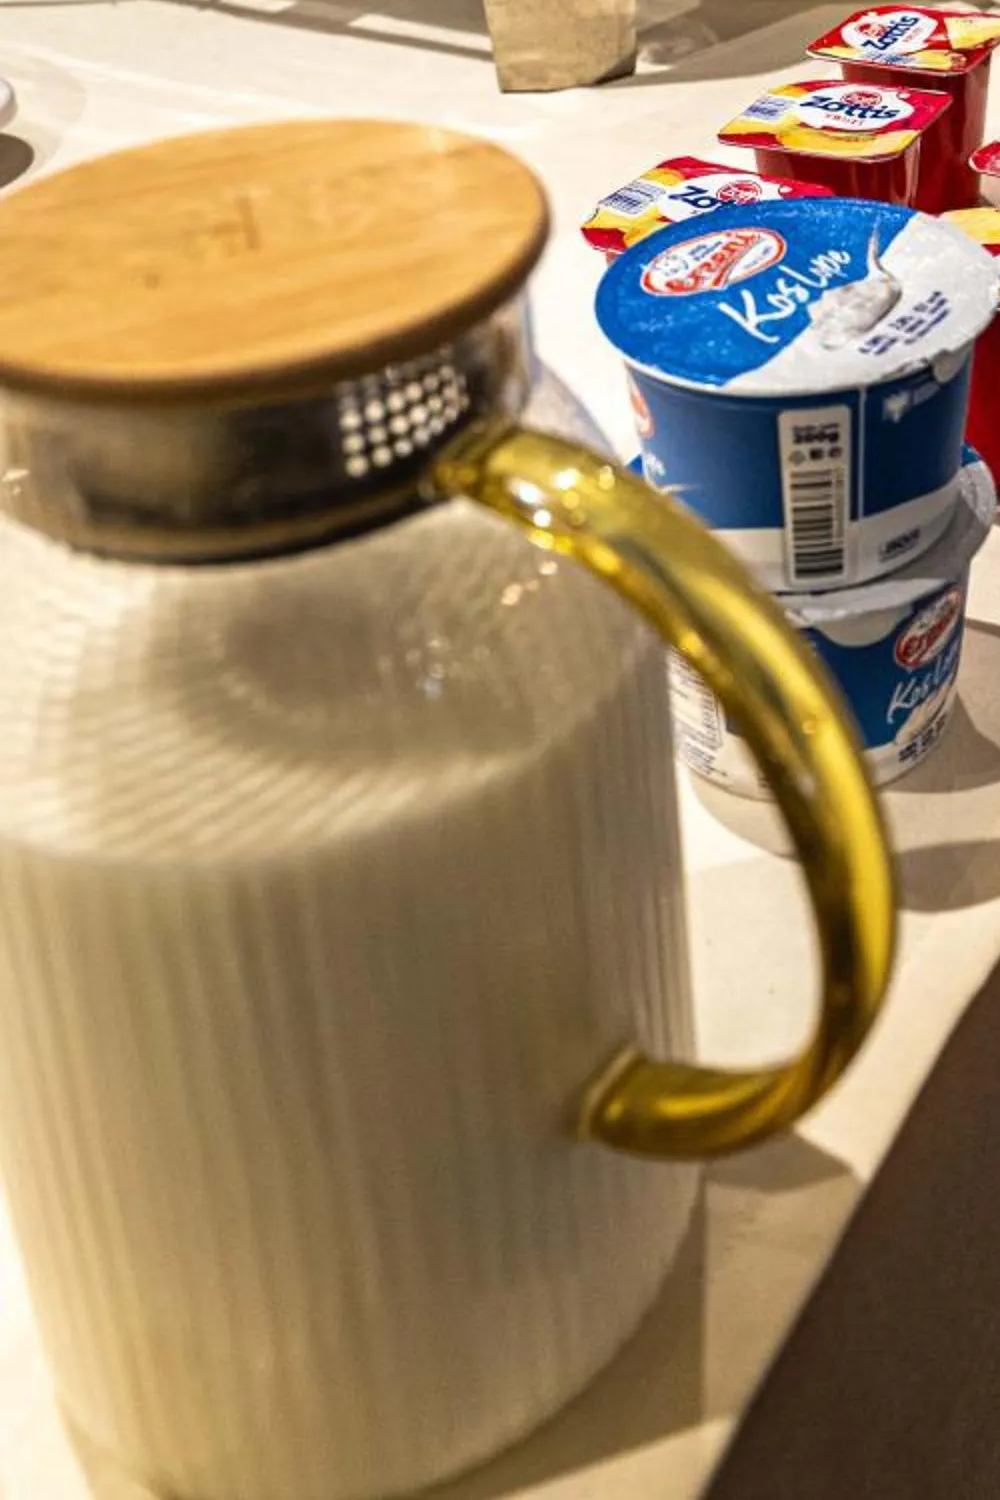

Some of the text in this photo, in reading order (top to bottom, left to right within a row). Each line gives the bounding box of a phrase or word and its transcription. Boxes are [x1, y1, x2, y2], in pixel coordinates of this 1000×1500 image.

[861, 15, 920, 51] Zottis
[800, 95, 900, 119] Zottis
[718, 278, 809, 343] Kos
